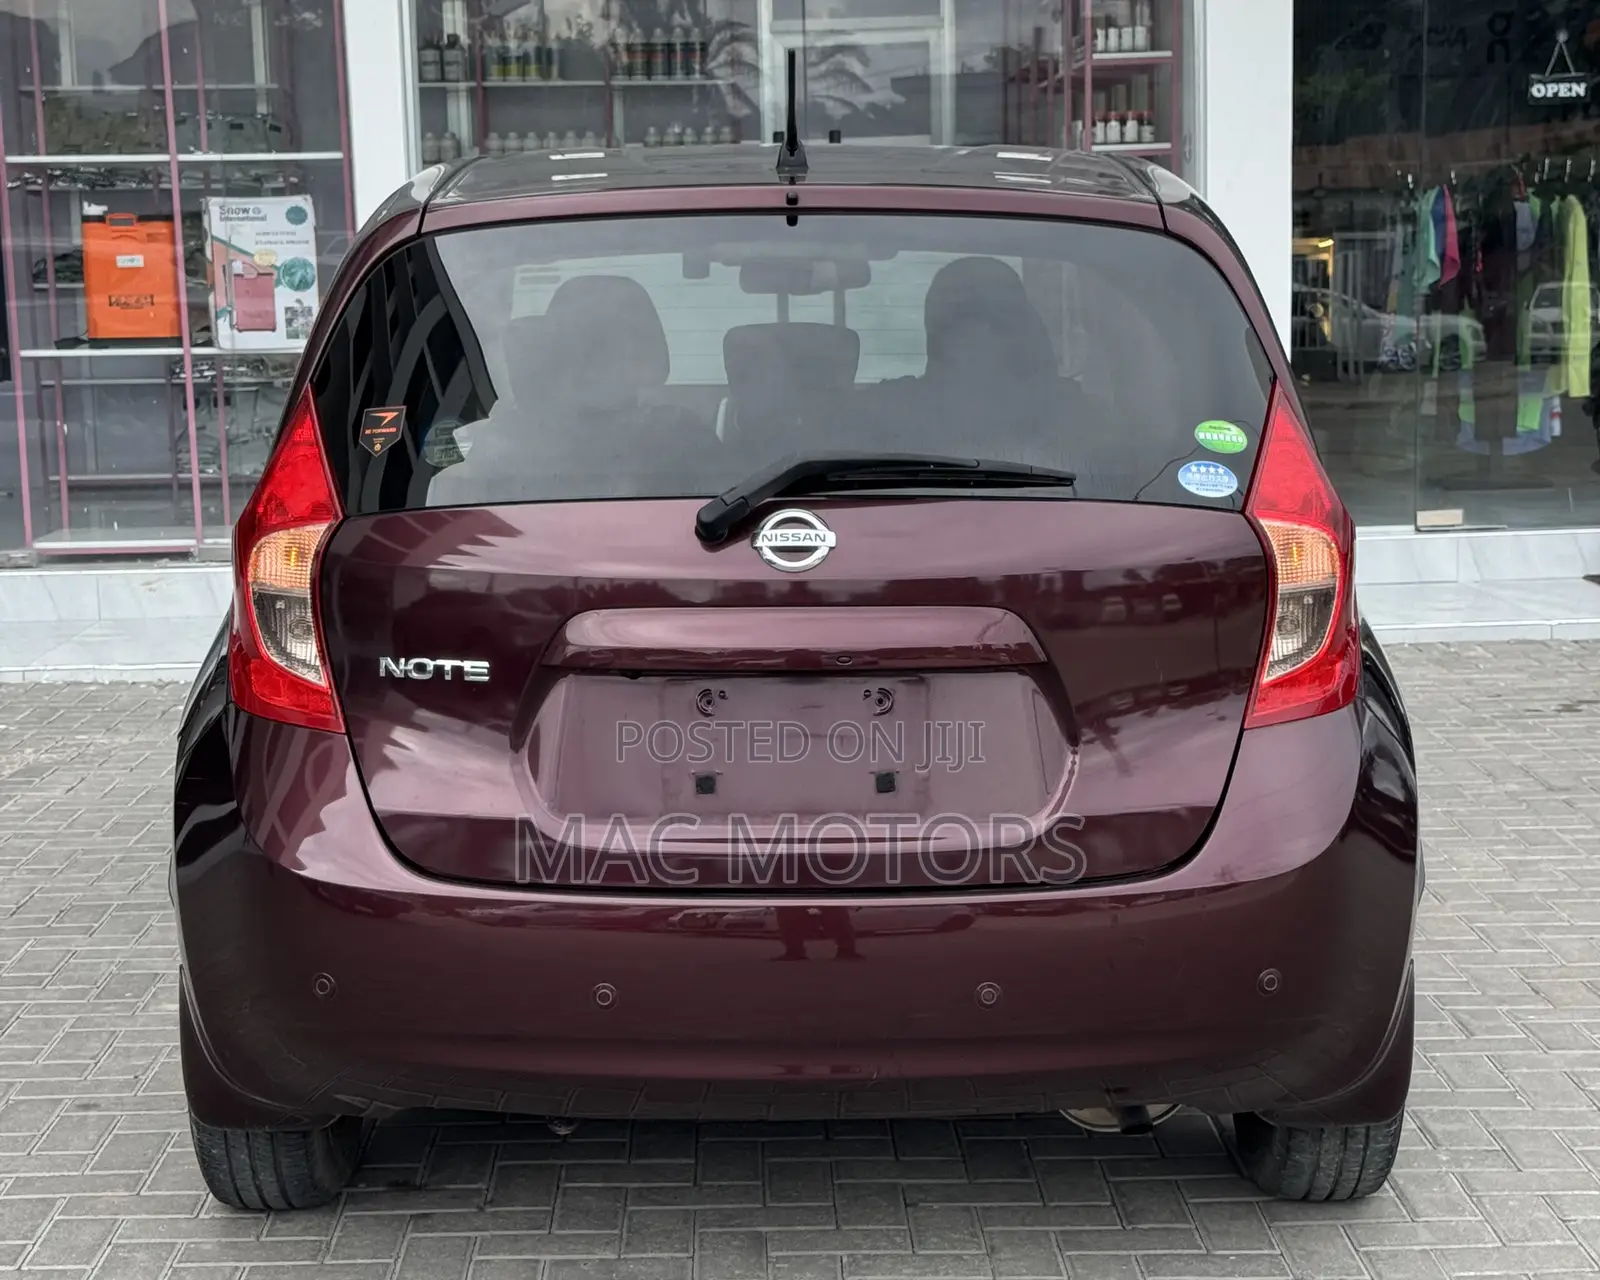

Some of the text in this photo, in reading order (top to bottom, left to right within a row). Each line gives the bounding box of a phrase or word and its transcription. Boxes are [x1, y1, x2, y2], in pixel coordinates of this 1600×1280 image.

[1531, 82, 1587, 98] OPEN
[220, 205, 251, 215] Snow
[761, 532, 826, 542] NISSAN
[379, 657, 490, 682] NOTE
